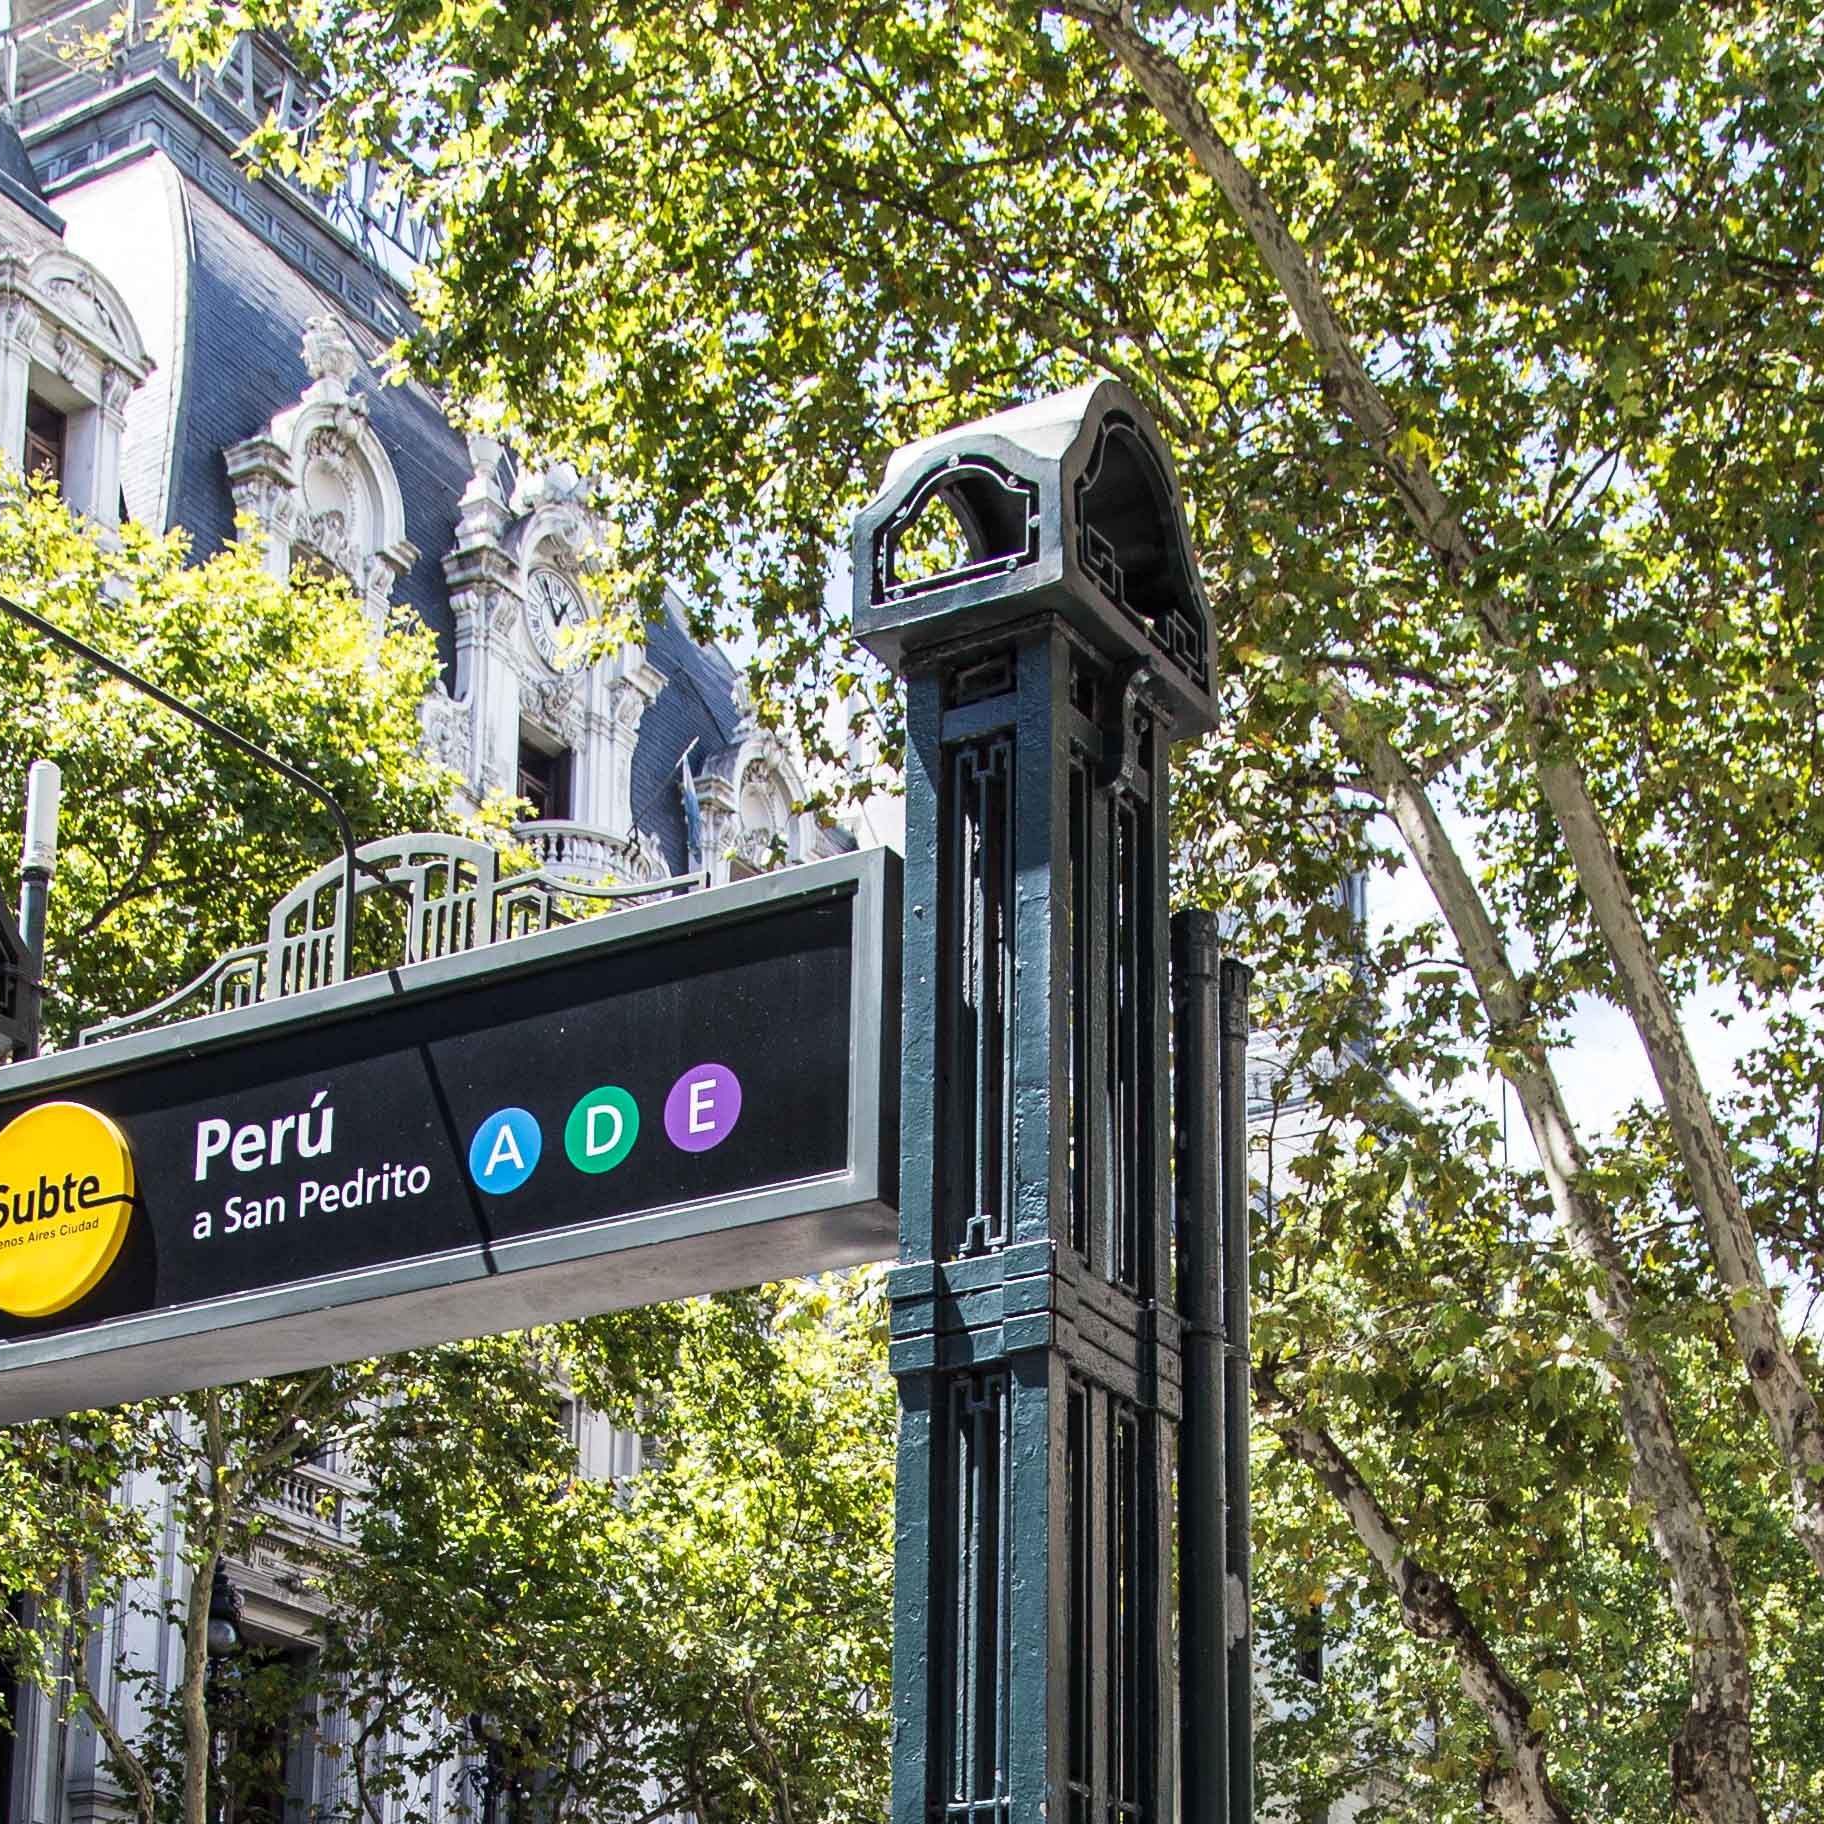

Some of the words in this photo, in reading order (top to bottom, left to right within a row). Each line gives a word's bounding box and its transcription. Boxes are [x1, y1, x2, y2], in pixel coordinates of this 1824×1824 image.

[195, 1090, 334, 1182] Perú
[484, 1124, 526, 1177] A
[586, 1104, 624, 1157] D
[688, 1078, 717, 1134] E
[28, 1229, 56, 1244] Aires
[60, 1216, 100, 1236] Ciudad
[193, 1211, 212, 1240] a
[224, 1196, 286, 1233] San
[299, 1163, 431, 1218] Pedrito
